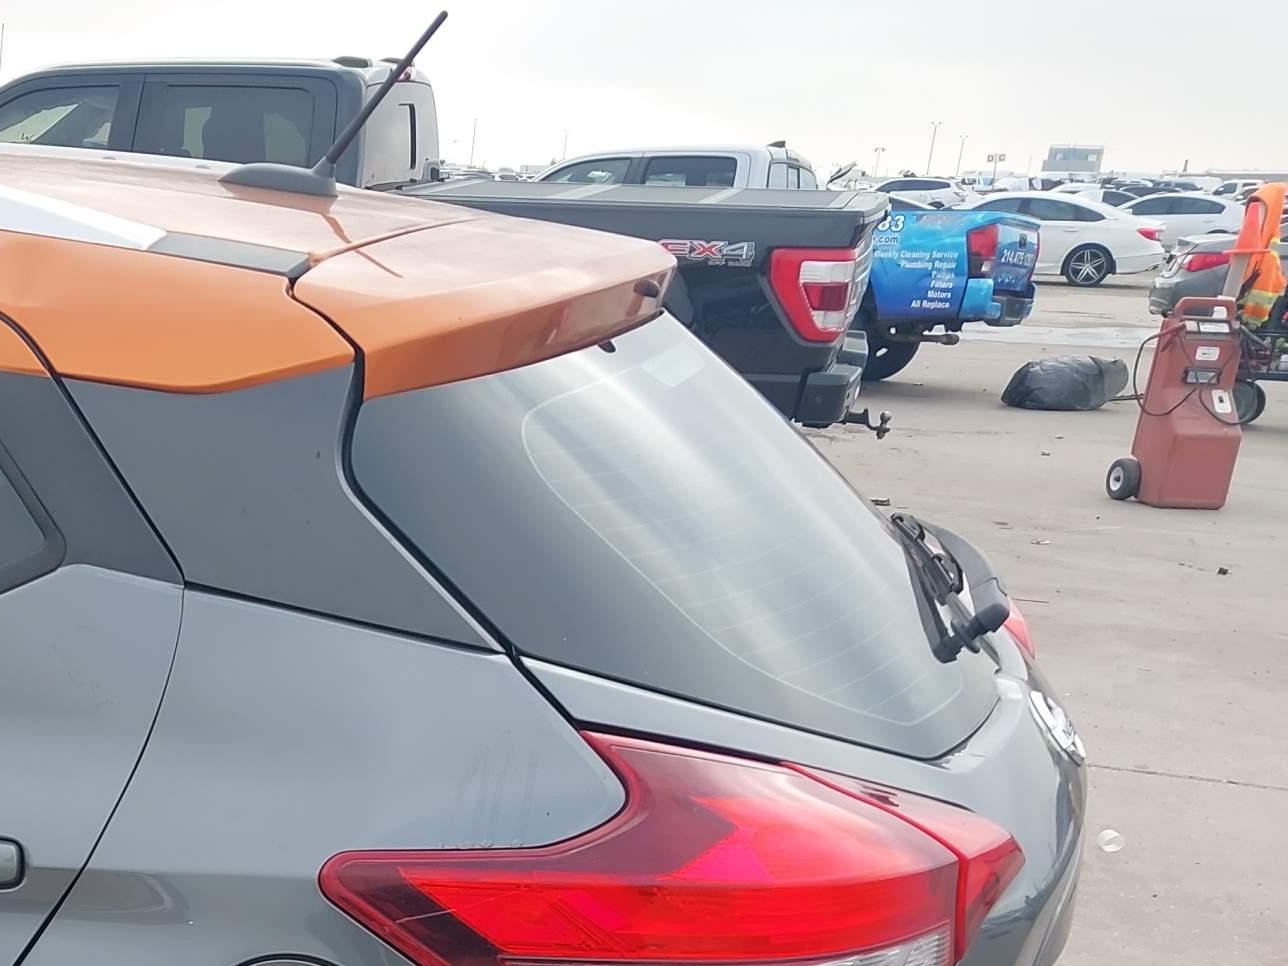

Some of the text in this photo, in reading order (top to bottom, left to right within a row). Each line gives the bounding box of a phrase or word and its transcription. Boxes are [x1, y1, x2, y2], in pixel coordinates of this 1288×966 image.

[900, 250, 931, 261] Cleaning
[932, 250, 959, 259] Service
[900, 260, 958, 270] Plumbing Repair
[930, 279, 953, 289] Filters
[927, 289, 952, 298] Motors
[911, 299, 950, 310] All Replace
